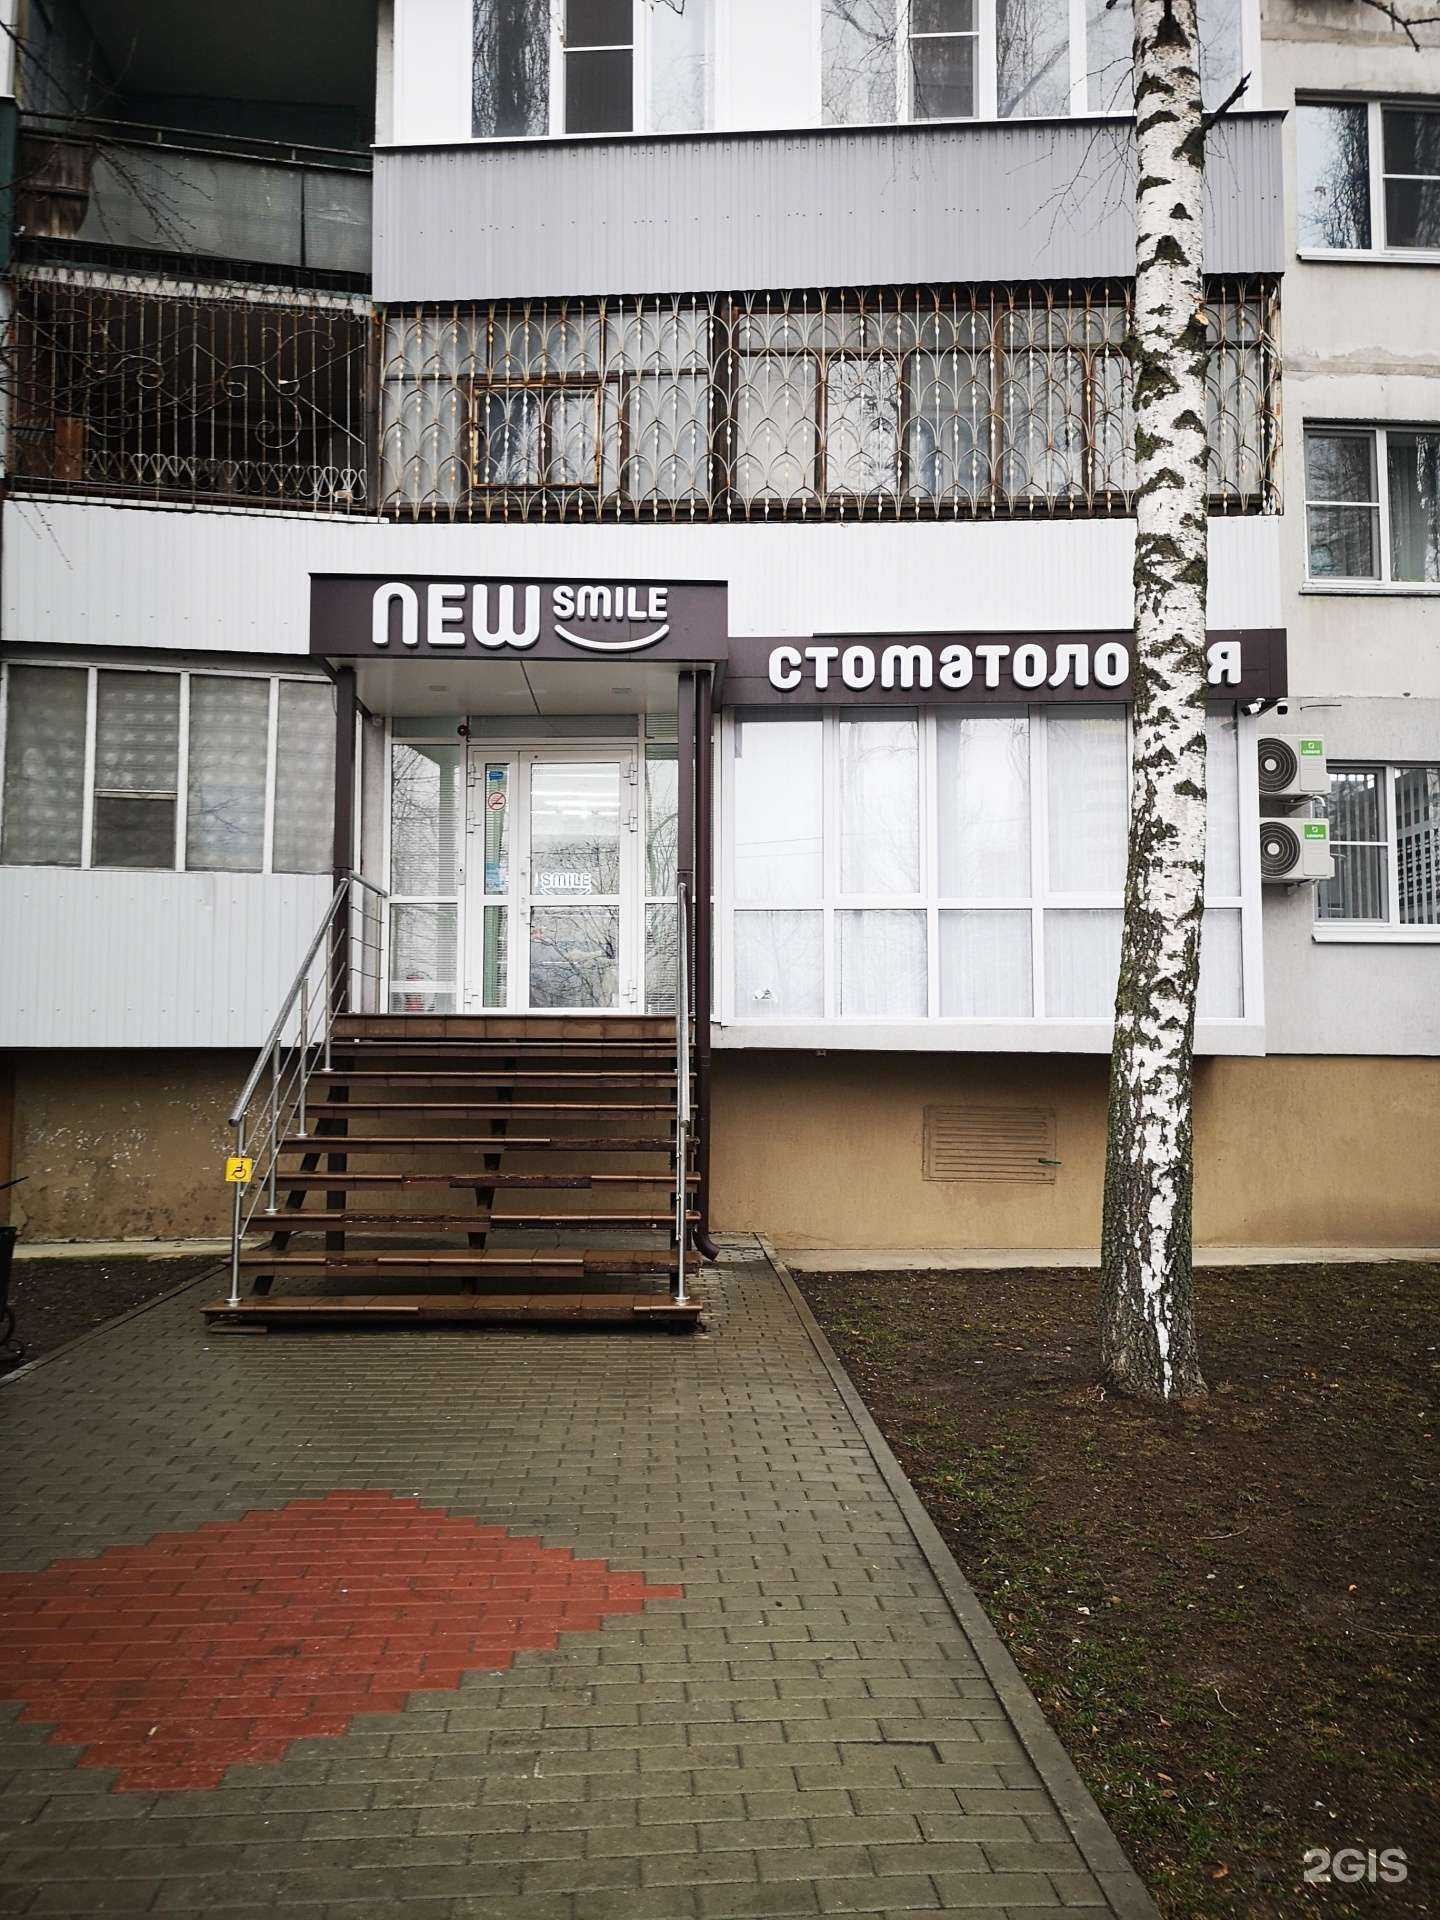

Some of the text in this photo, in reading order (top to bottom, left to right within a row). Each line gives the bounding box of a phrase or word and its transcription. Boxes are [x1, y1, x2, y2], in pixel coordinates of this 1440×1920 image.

[371, 582, 669, 649] NEW SMILE
[768, 641, 1242, 690] стоматолоя
